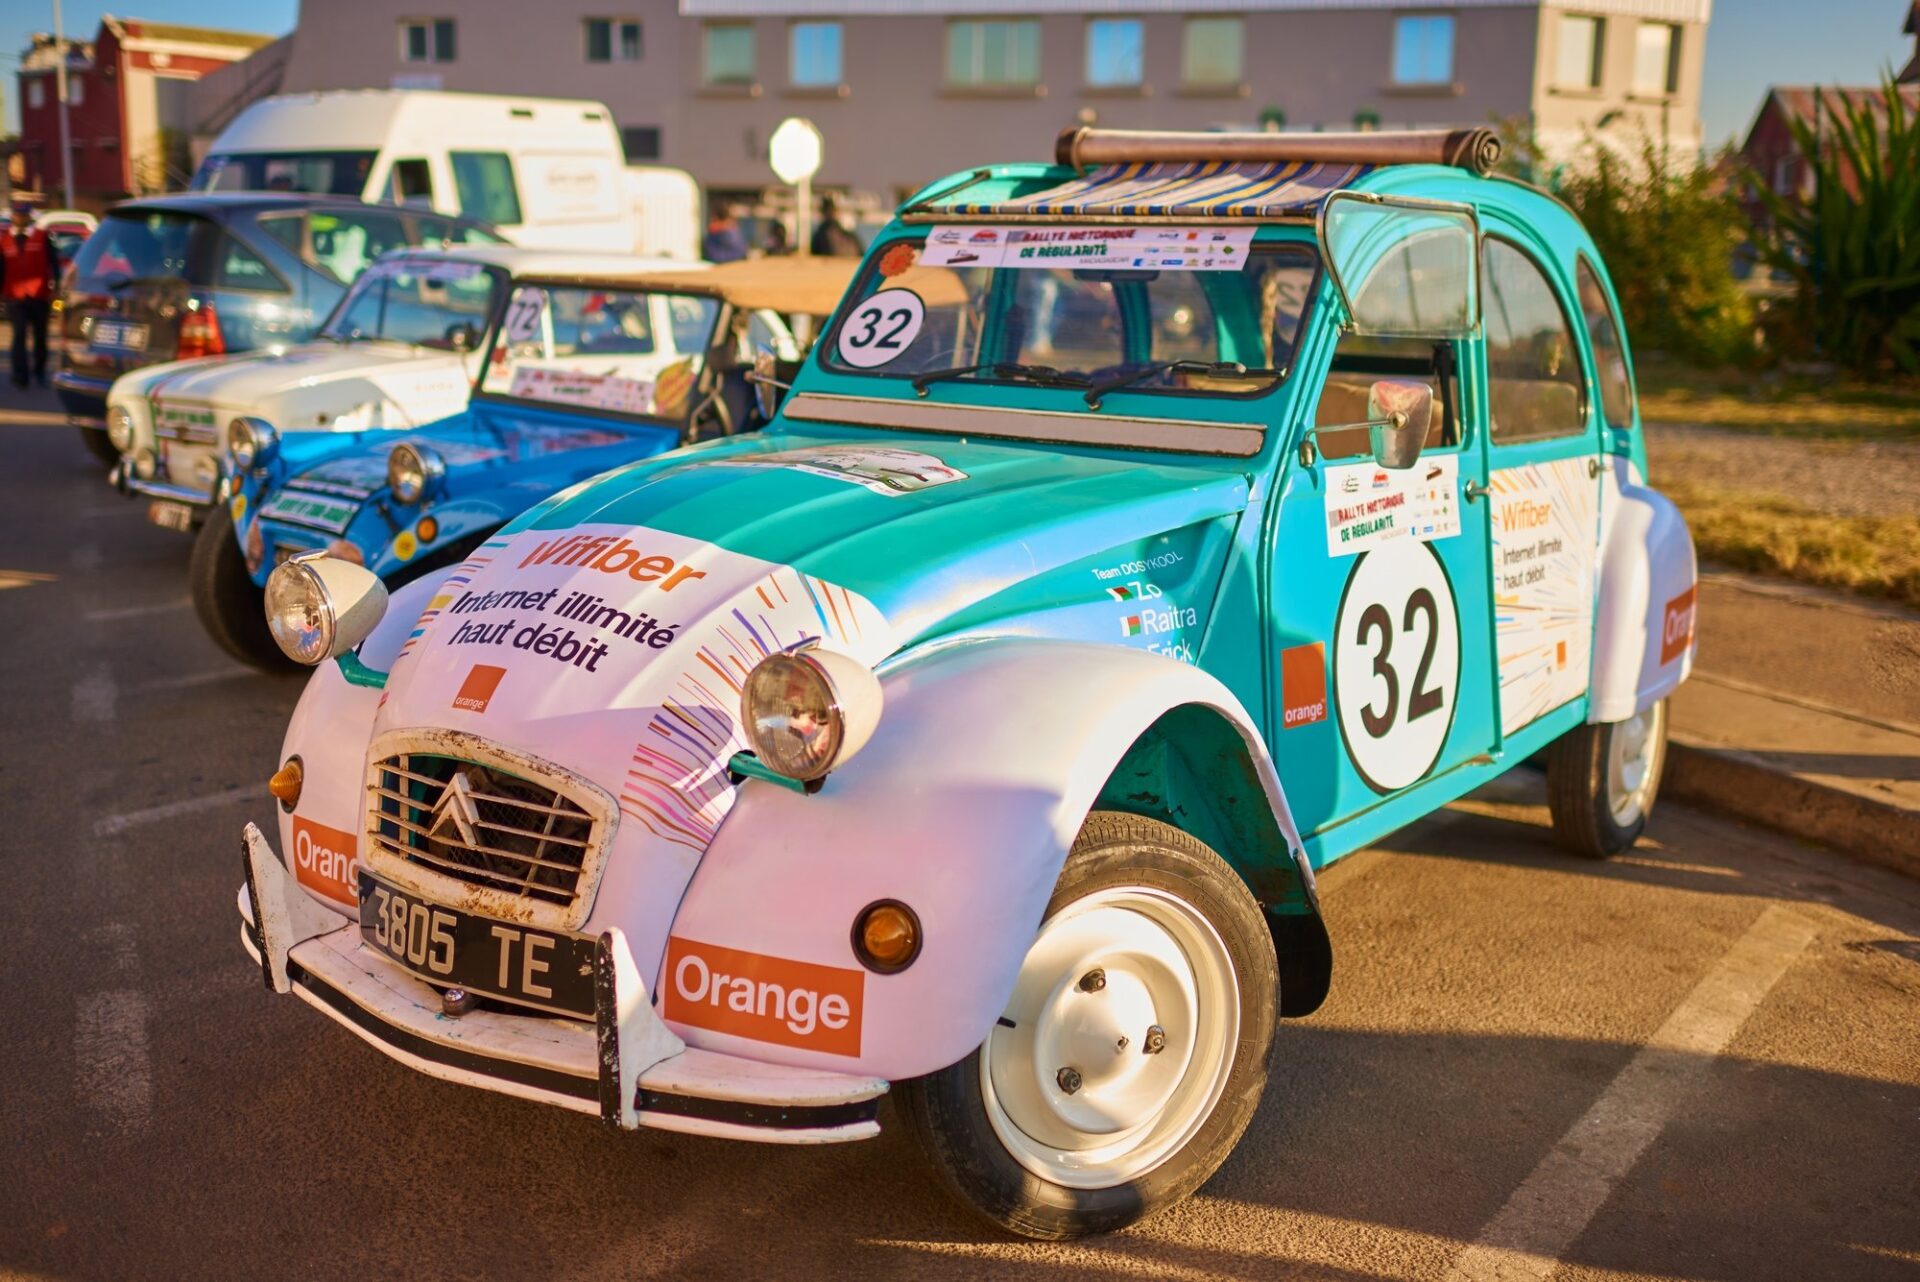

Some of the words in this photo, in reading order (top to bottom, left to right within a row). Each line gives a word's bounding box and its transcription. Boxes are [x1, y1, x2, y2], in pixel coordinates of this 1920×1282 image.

[1023, 231, 1067, 242] RALLYE
[1067, 229, 1137, 240] HISTORIQUE
[1019, 247, 1036, 258] DE
[850, 308, 912, 348] 32
[1338, 502, 1366, 522] RALLYE
[1366, 492, 1405, 514] HISTORIQUE
[1502, 499, 1551, 533] Wifiber
[1341, 527, 1350, 542] DE
[517, 535, 706, 593] Wifiber
[1091, 567, 1121, 581] Team
[1120, 551, 1184, 576] DOSYKOOL
[1503, 544, 1535, 566] Internet
[1538, 538, 1562, 556] illimité
[1127, 581, 1163, 601] Zo
[1503, 570, 1523, 591] haut
[449, 588, 559, 615] Internet
[553, 591, 681, 650] illimité
[1141, 605, 1197, 635] Raitra
[448, 619, 517, 646] haut
[512, 622, 609, 673] débit
[1356, 587, 1444, 739] 32
[455, 696, 485, 711] orange
[1285, 702, 1323, 723] orange
[374, 887, 457, 976] 3805
[491, 925, 556, 999] TE
[675, 955, 850, 1035] Orange
